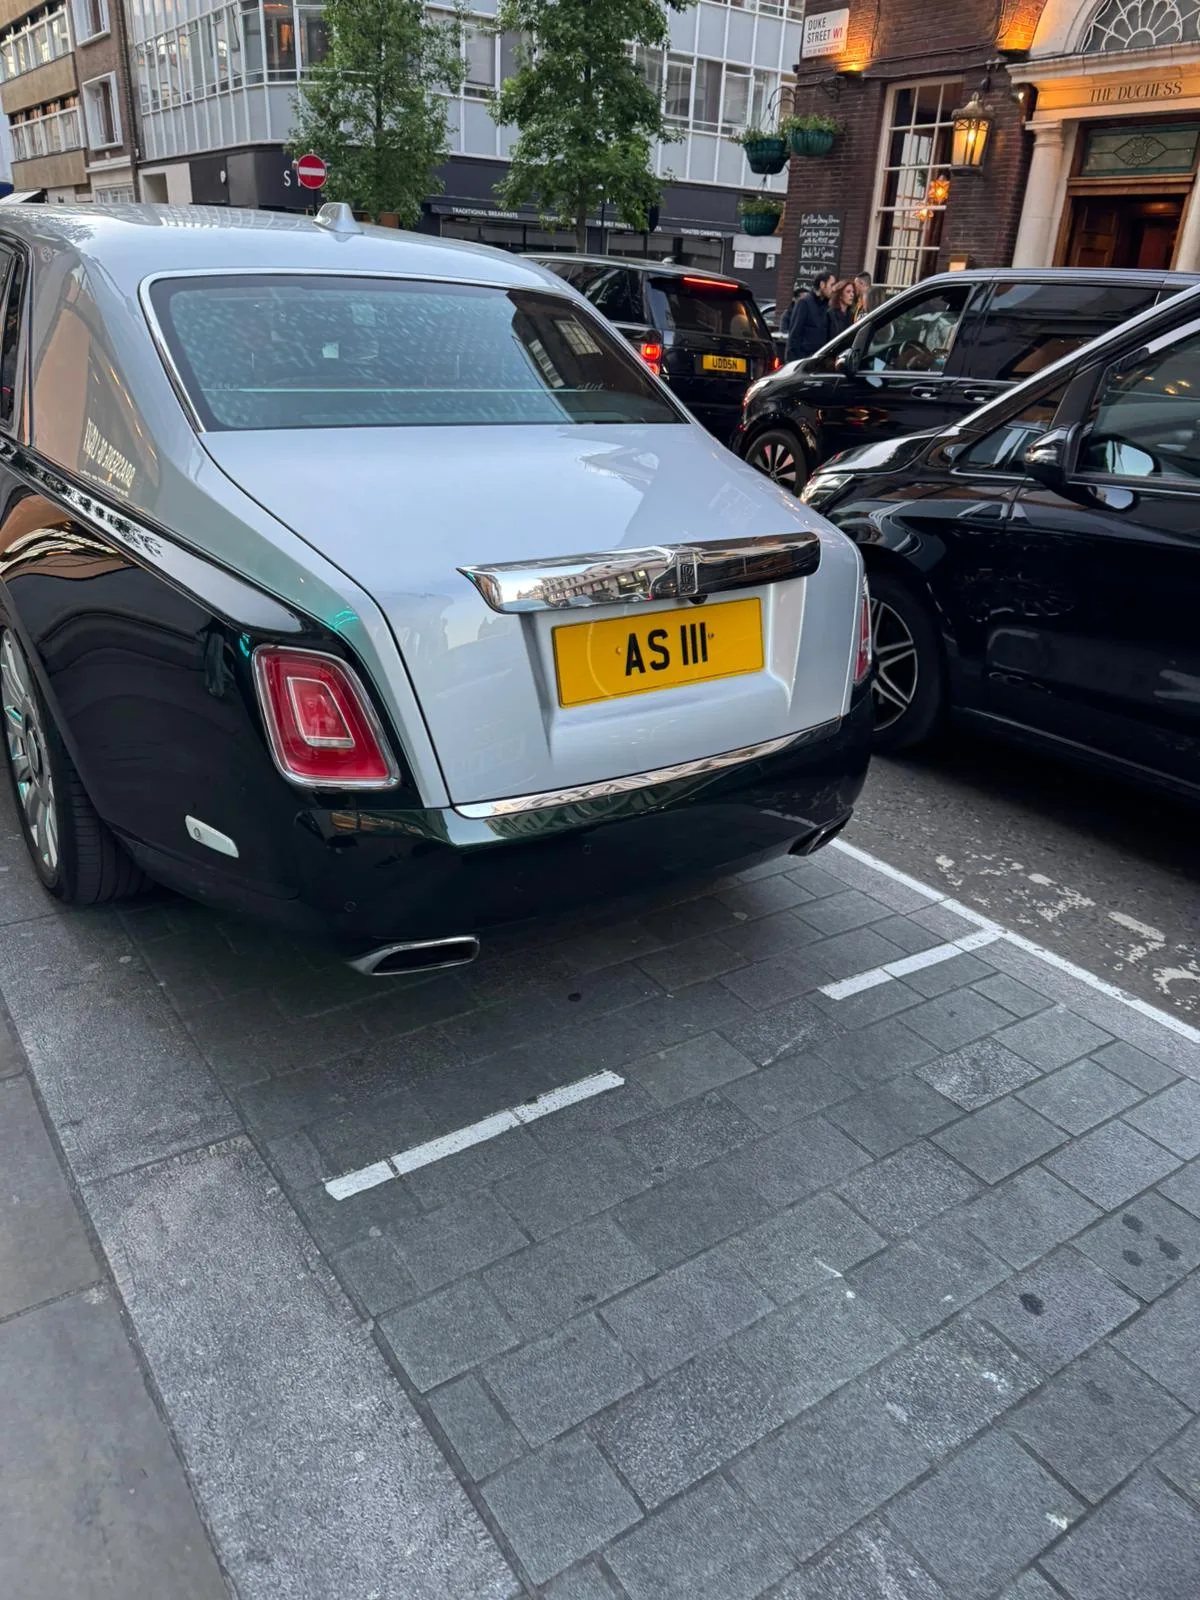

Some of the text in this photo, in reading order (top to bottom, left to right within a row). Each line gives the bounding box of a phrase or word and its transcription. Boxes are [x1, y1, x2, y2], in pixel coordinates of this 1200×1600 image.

[808, 17, 827, 31] DUKE
[806, 26, 843, 44] STREET W1
[1089, 81, 1182, 102] THE DUCHESS
[452, 207, 488, 217] TRADITIONAL
[625, 628, 670, 676] AS
